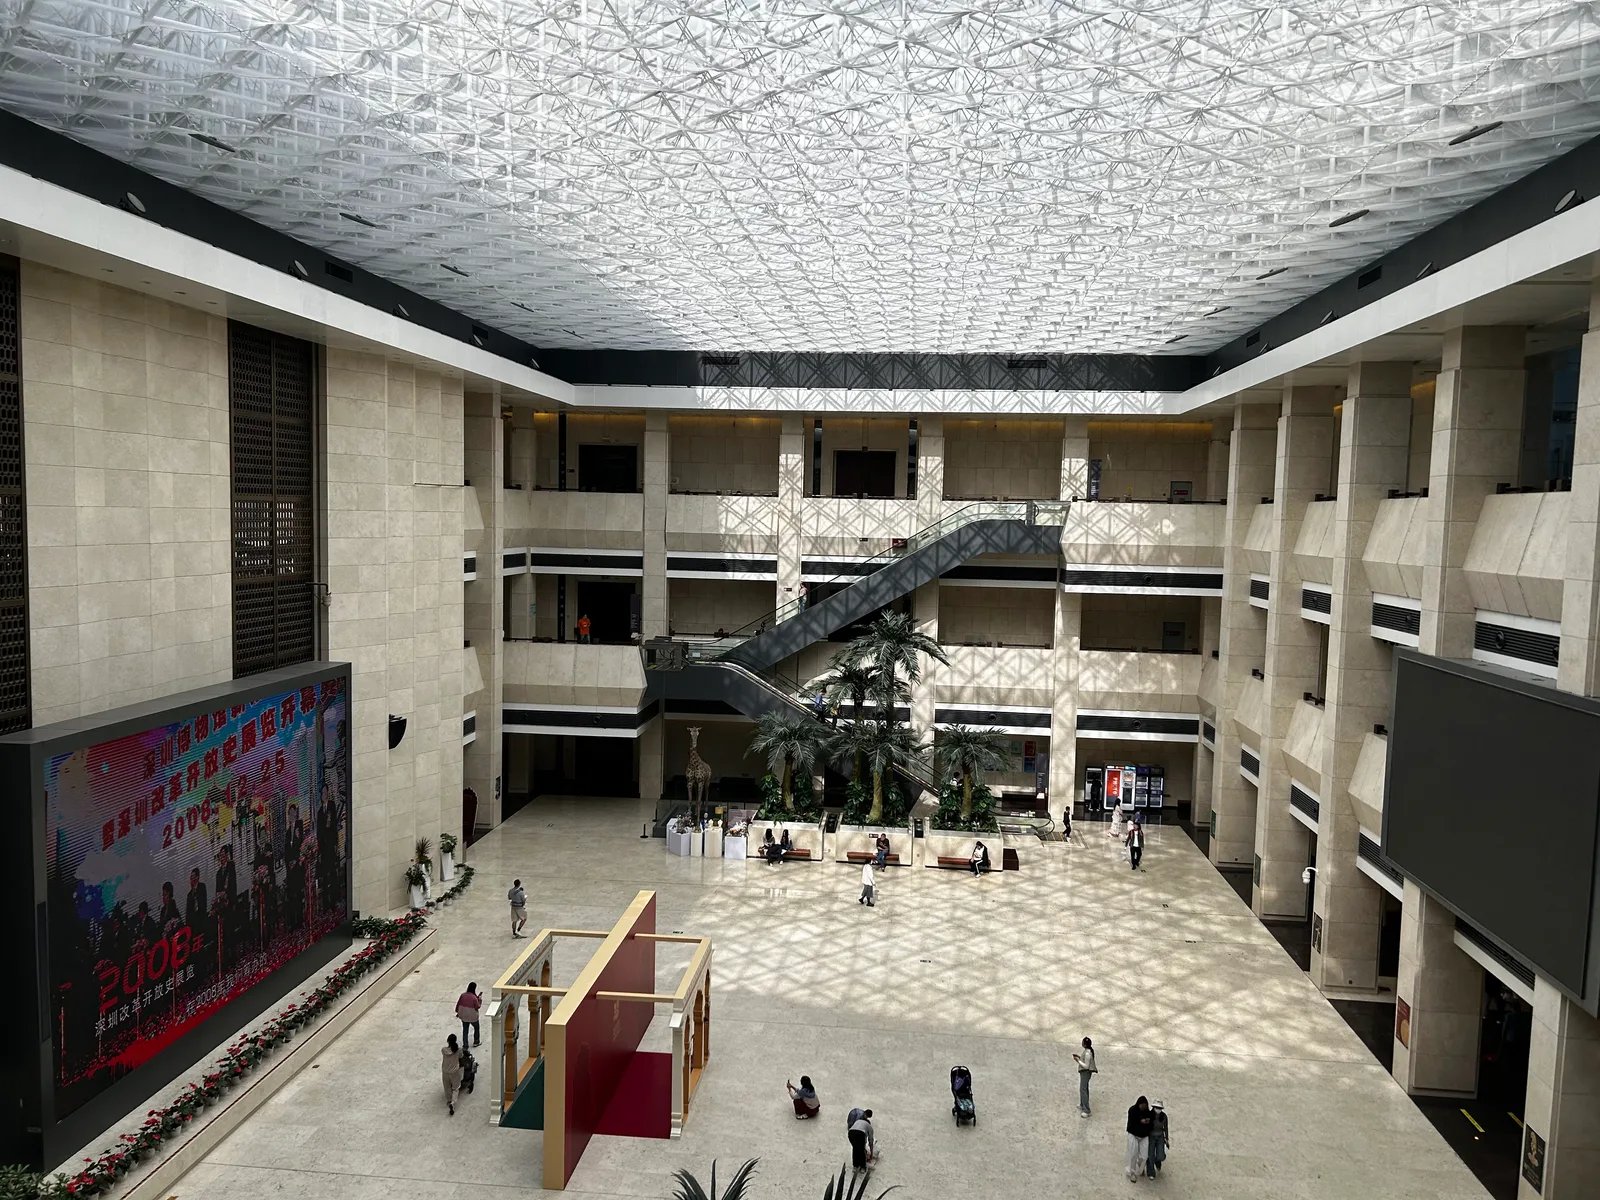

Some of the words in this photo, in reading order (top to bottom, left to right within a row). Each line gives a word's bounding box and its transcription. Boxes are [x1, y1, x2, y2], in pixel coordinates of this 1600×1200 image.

[94, 963, 196, 1038] 深圳改革开放史展览
